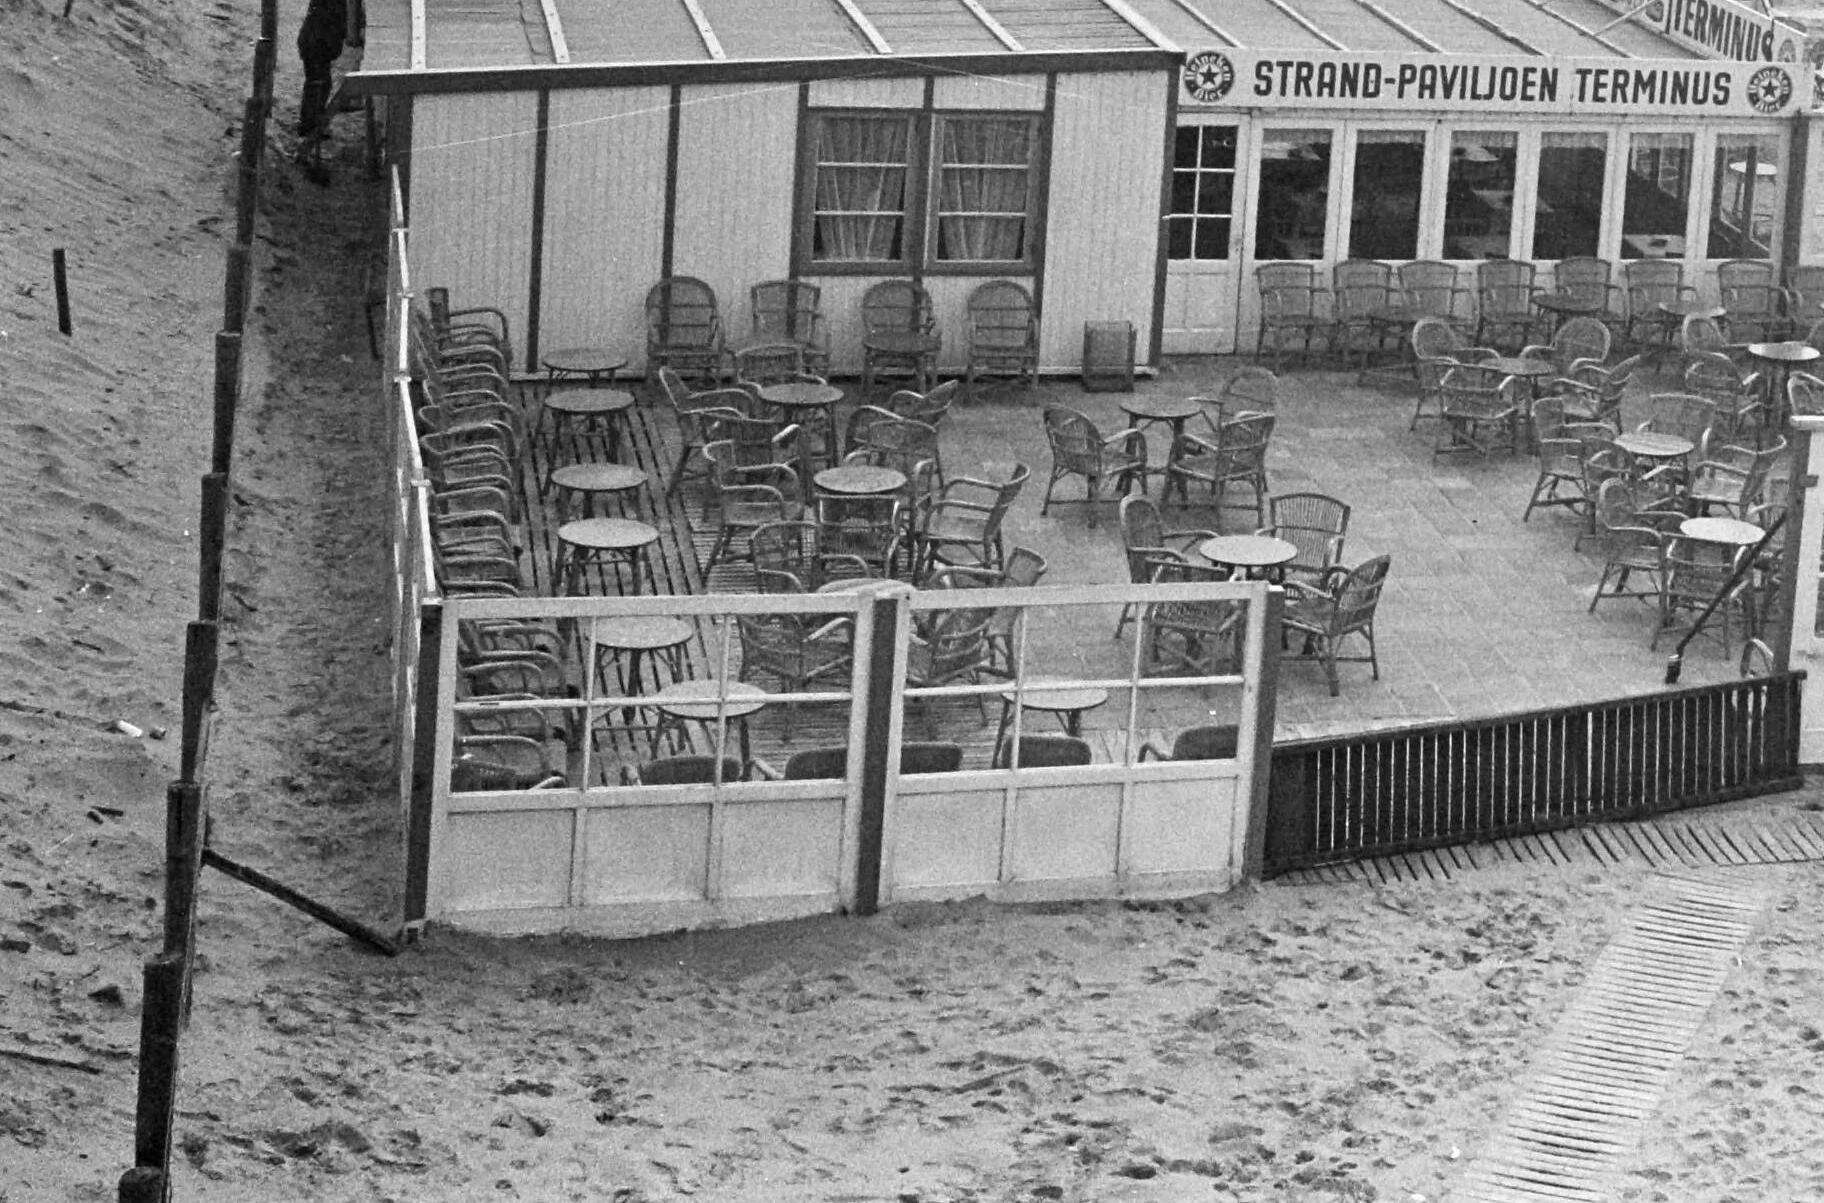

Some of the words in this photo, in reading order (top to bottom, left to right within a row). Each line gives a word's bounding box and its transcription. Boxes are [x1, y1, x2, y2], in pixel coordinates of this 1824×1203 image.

[1184, 54, 1231, 81] Heineken
[1193, 88, 1223, 102] Bier
[1254, 60, 1558, 102] STRAND-PAVILJOEN
[1576, 68, 1731, 105] TERMINUS
[1747, 69, 1789, 95] Heineken
[1754, 101, 1780, 113] Bier
